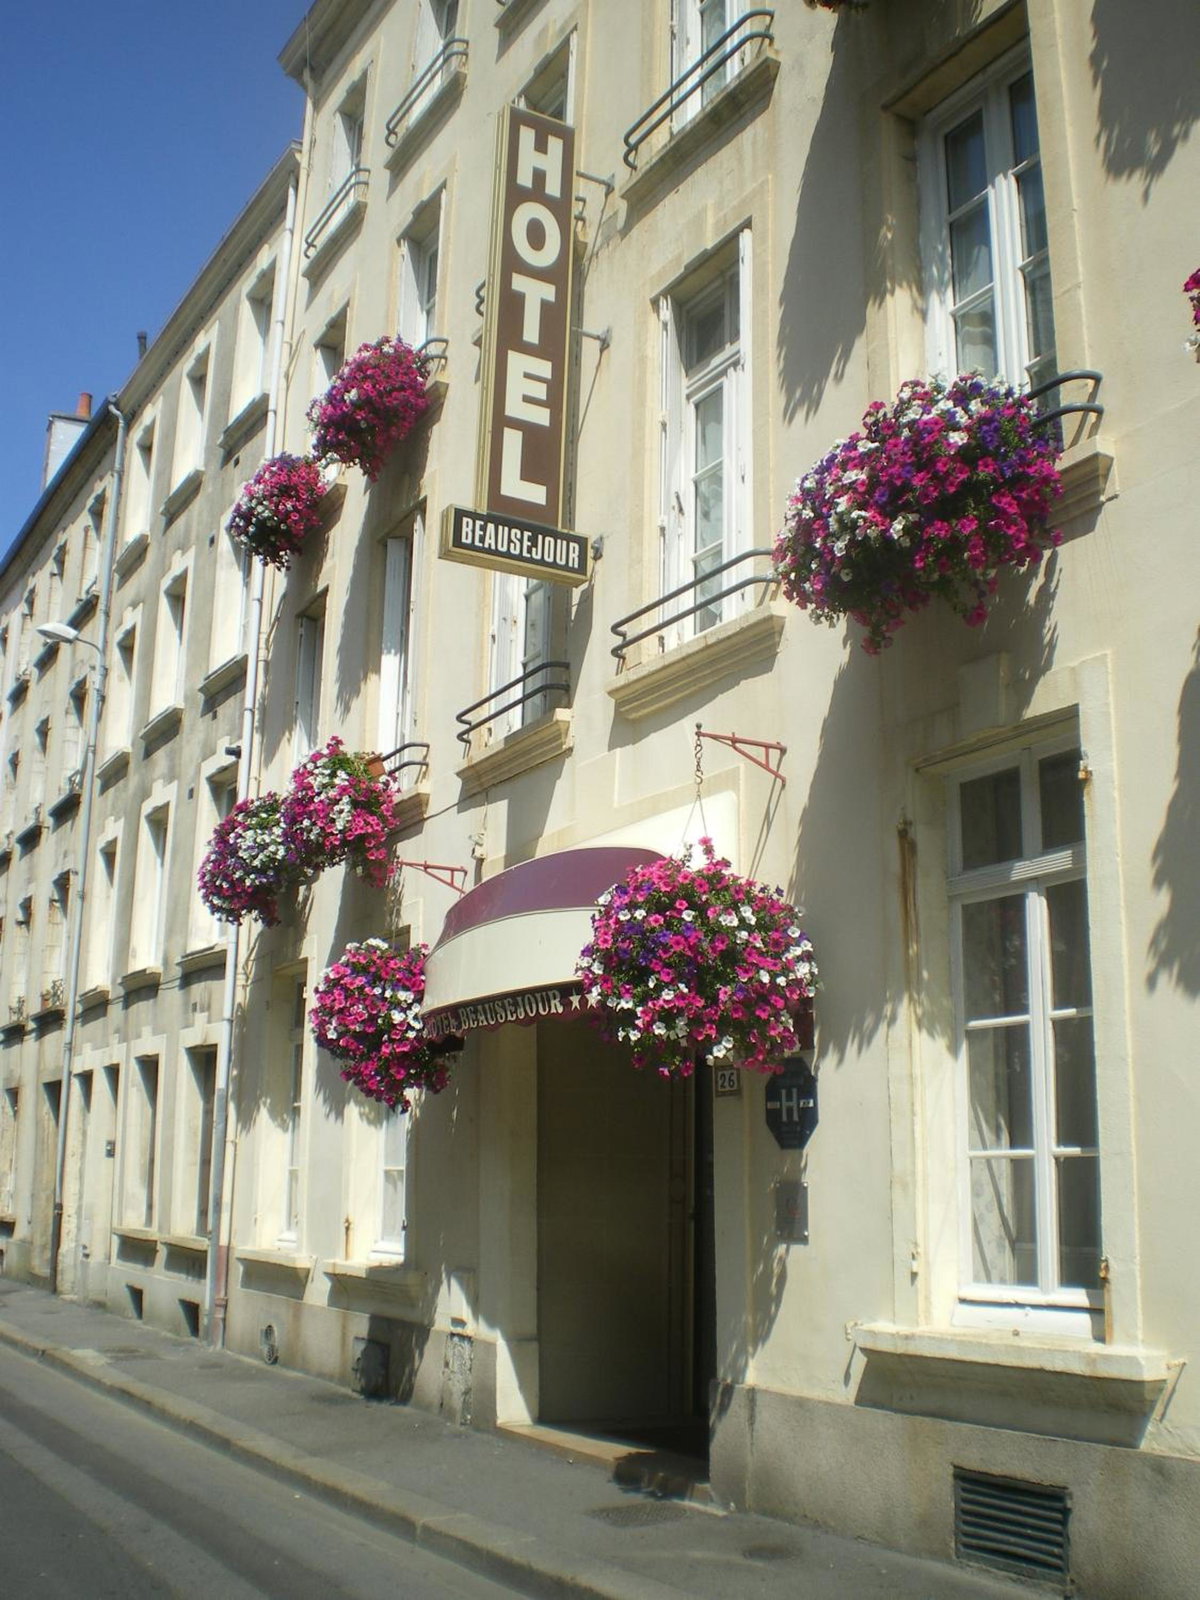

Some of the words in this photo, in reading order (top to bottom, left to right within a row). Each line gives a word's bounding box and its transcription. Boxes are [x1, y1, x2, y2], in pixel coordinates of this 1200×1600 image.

[500, 125, 564, 506] HOTEL
[461, 516, 580, 569] BEAUSEJOUR
[459, 990, 564, 1030] BEAUSEJOUR
[719, 1072, 735, 1089] 26
[780, 1087, 800, 1123] H
